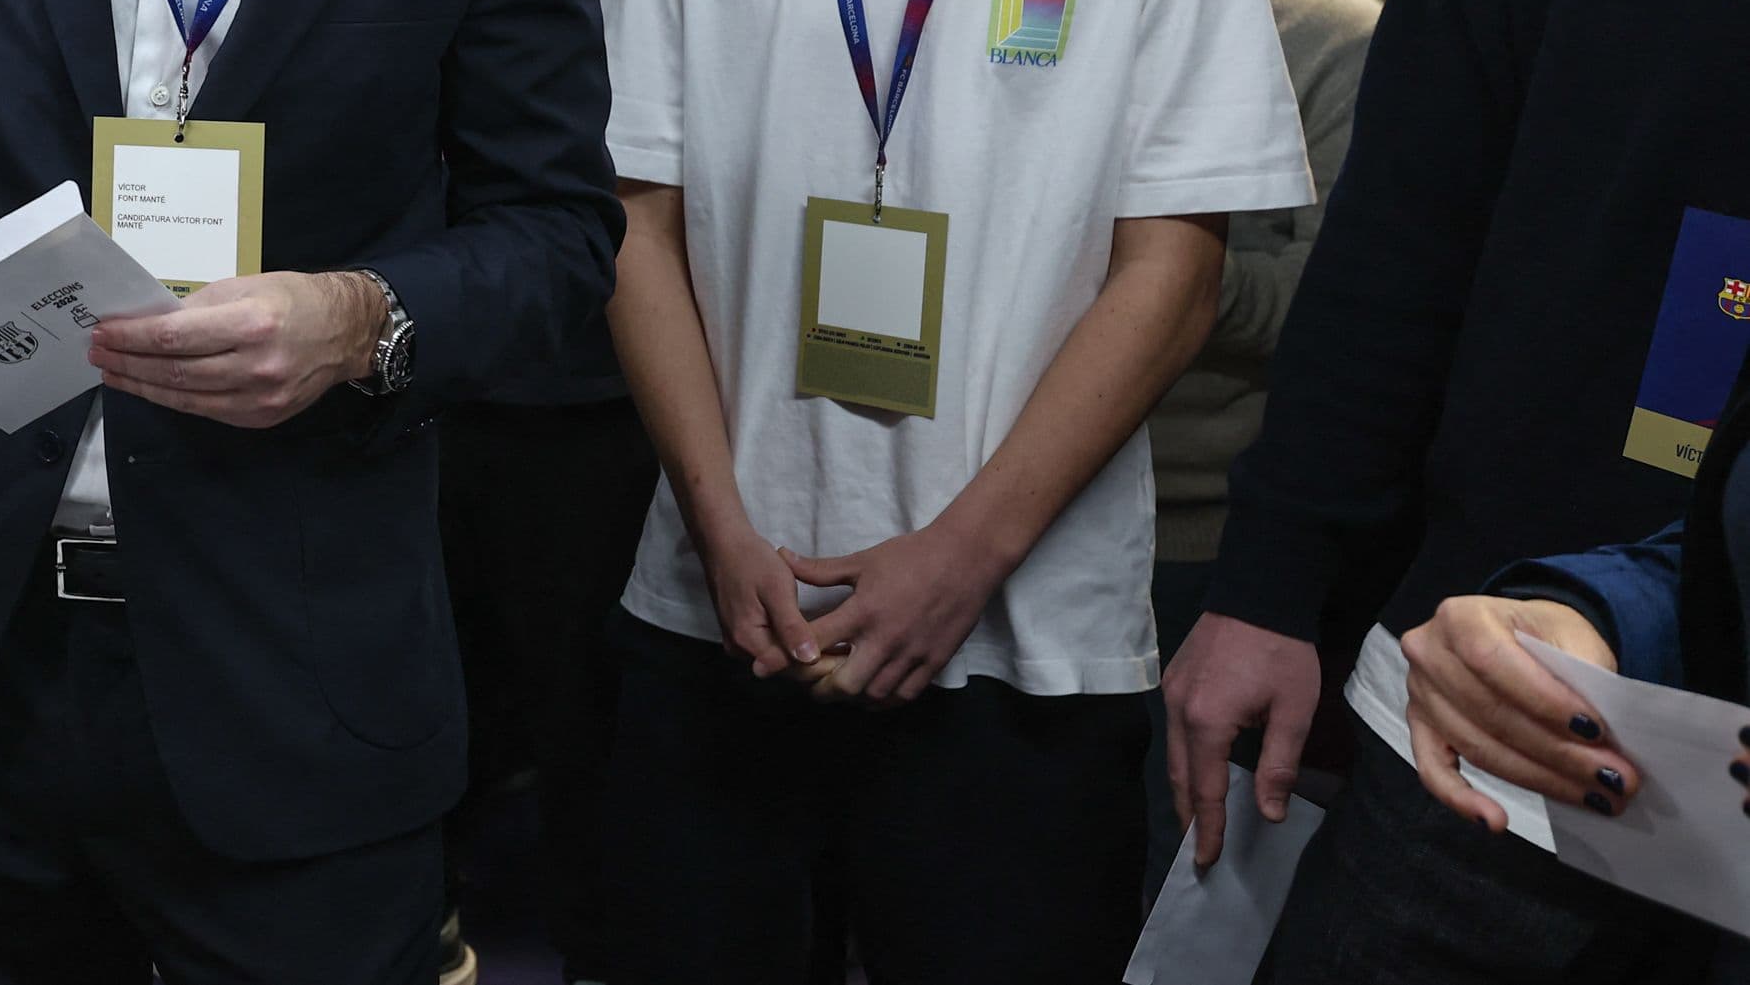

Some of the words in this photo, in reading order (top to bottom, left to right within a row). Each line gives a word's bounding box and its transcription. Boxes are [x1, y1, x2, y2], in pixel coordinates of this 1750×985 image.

[990, 48, 1057, 67] BLANCA
[118, 183, 146, 192] VÍCTOR
[140, 195, 166, 203] MANTÉ
[117, 214, 171, 223] CANDIDATURA
[172, 215, 201, 225] VÍCTOR
[202, 217, 223, 225] FONT
[117, 221, 143, 229] MANTÉ
[31, 282, 84, 311] ELECCIONS
[53, 295, 78, 309] 2026
[1676, 444, 1704, 464] VÍCT
